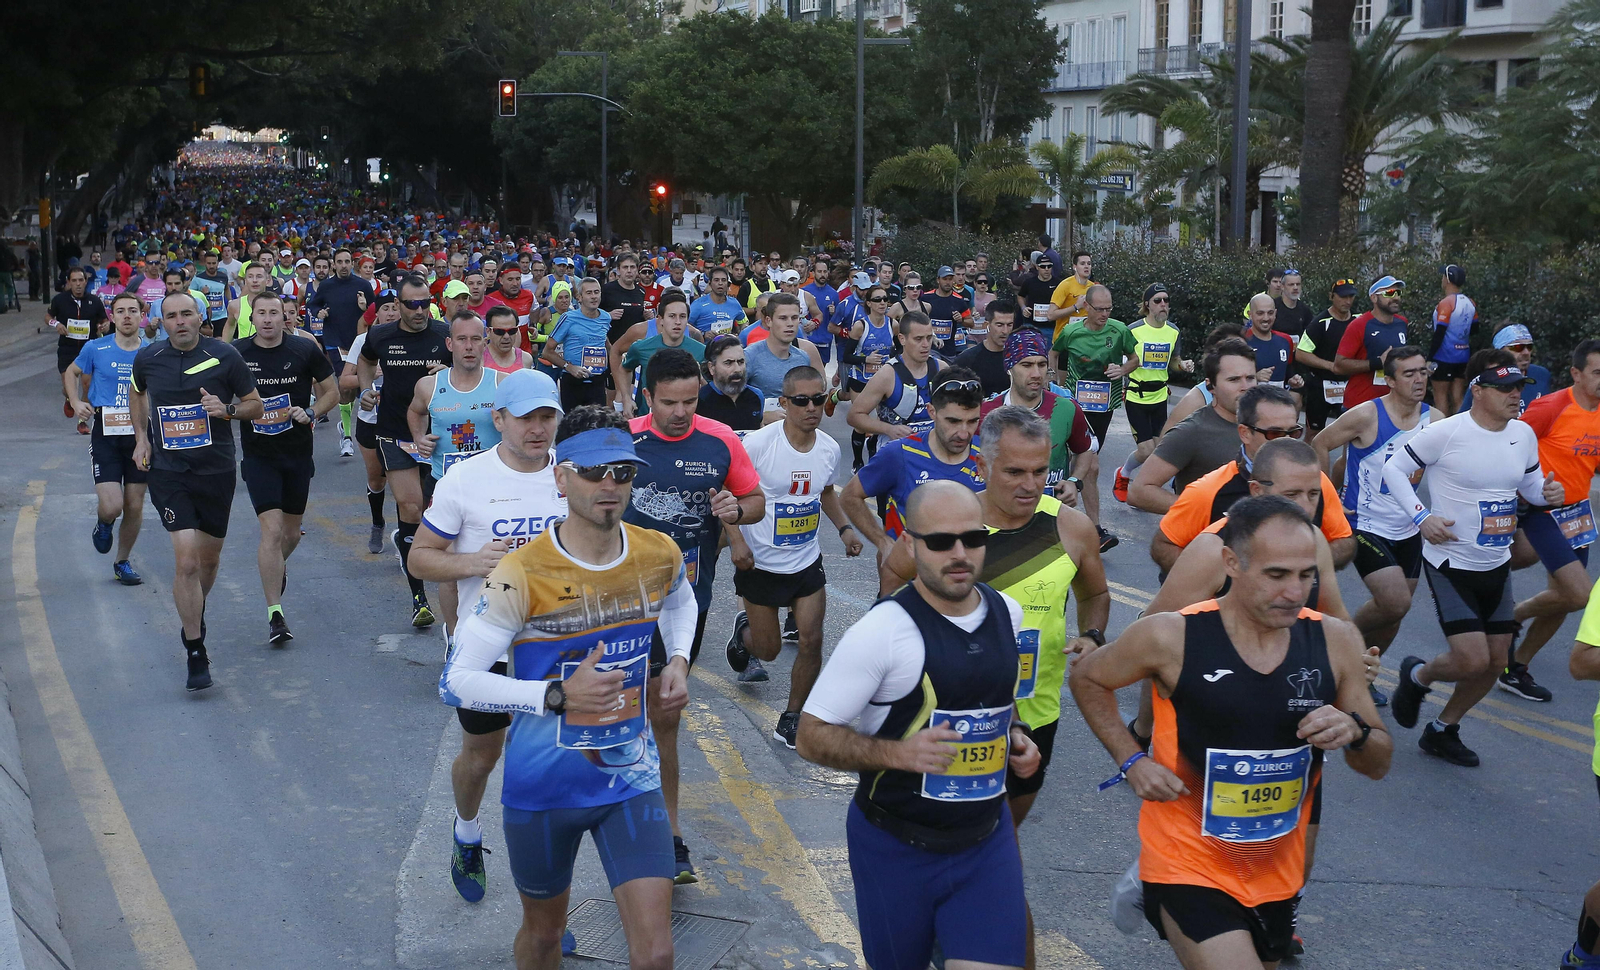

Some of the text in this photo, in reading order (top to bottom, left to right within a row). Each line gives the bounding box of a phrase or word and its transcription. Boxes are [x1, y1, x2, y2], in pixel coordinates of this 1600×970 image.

[174, 422, 195, 431] 1672
[1574, 448, 1600, 456] TRA
[790, 518, 809, 528] 1281
[488, 702, 536, 713] TRIATLÓN
[972, 720, 1000, 732] ZURICH
[960, 746, 995, 763] 1537
[1253, 762, 1292, 772] ZURICH
[1242, 786, 1282, 804] 1490
